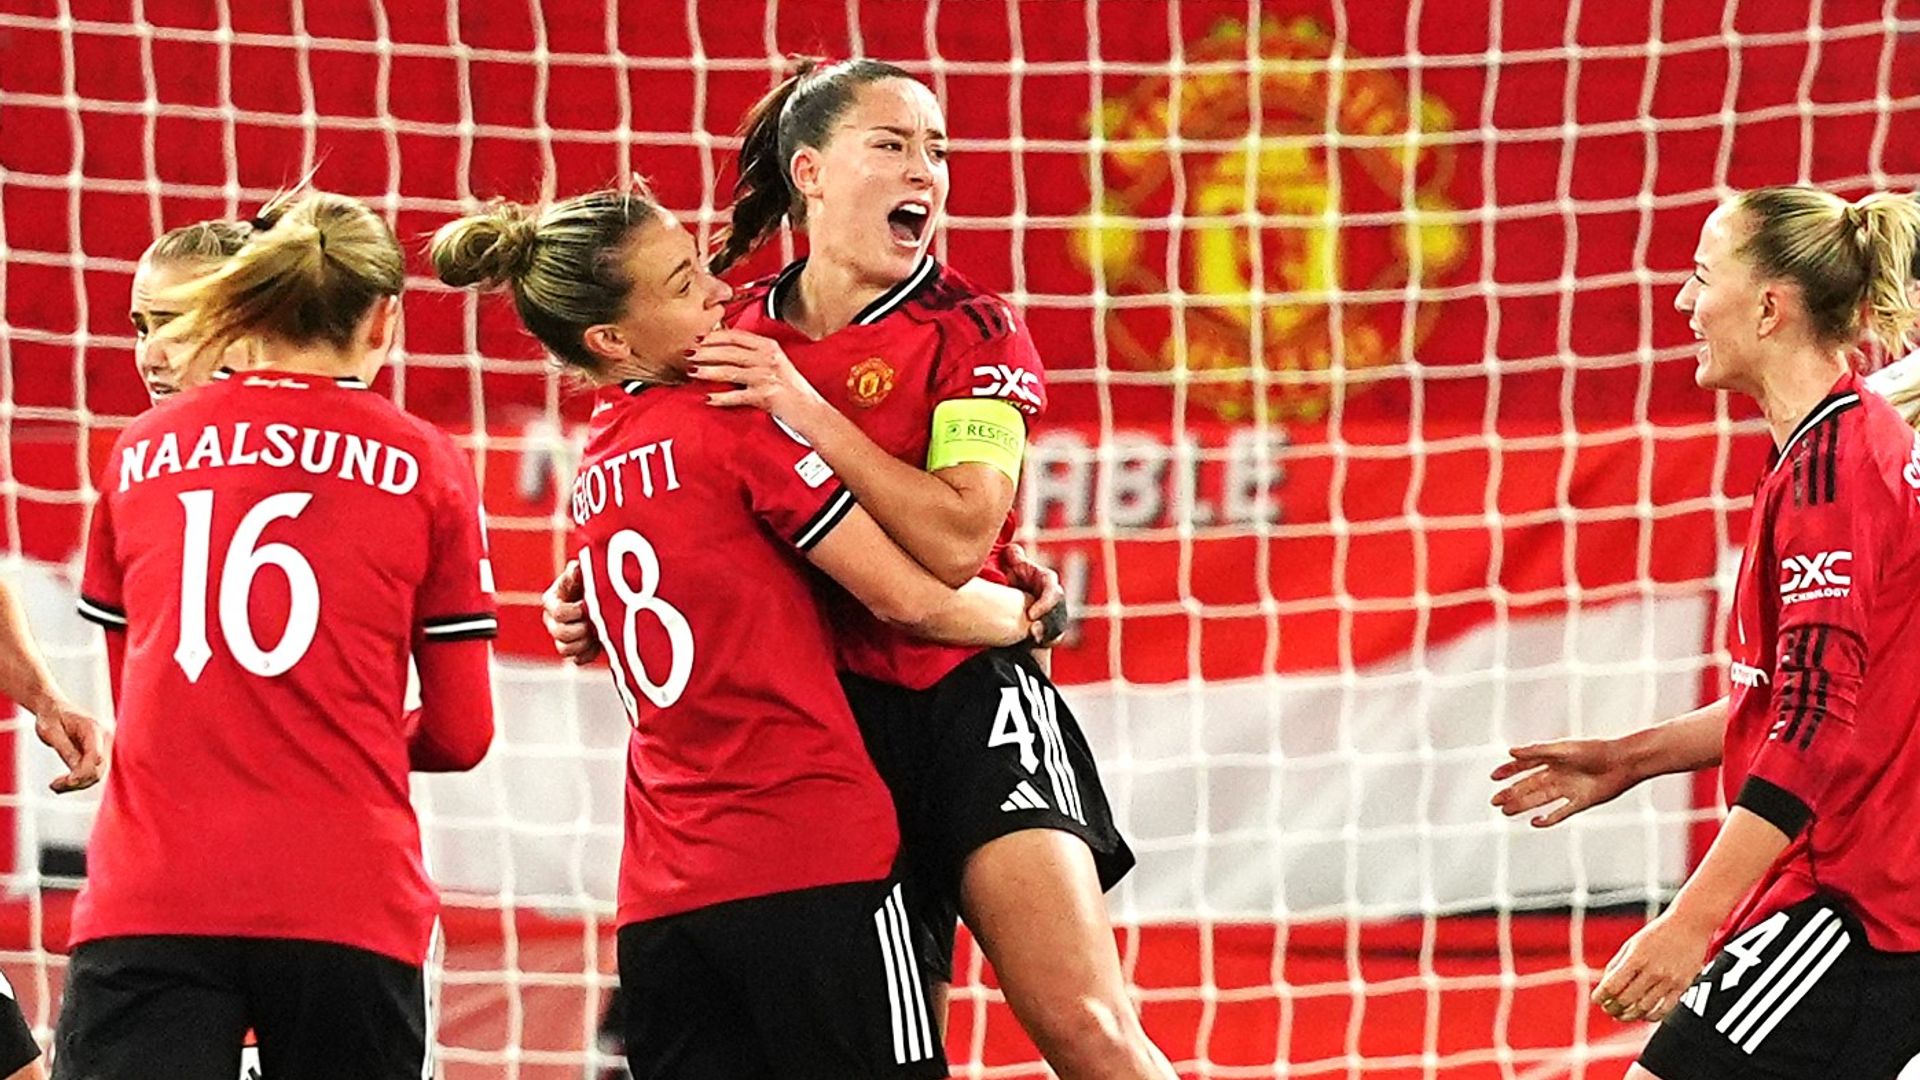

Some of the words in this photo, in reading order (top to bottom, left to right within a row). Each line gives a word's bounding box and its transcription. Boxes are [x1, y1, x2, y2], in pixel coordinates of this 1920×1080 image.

[118, 422, 419, 495] NAALSUND
[173, 489, 320, 684] 16
[1779, 550, 1853, 593] DXC
[578, 529, 696, 727] 18
[988, 686, 1040, 775] 4
[1701, 911, 1790, 992] 4
